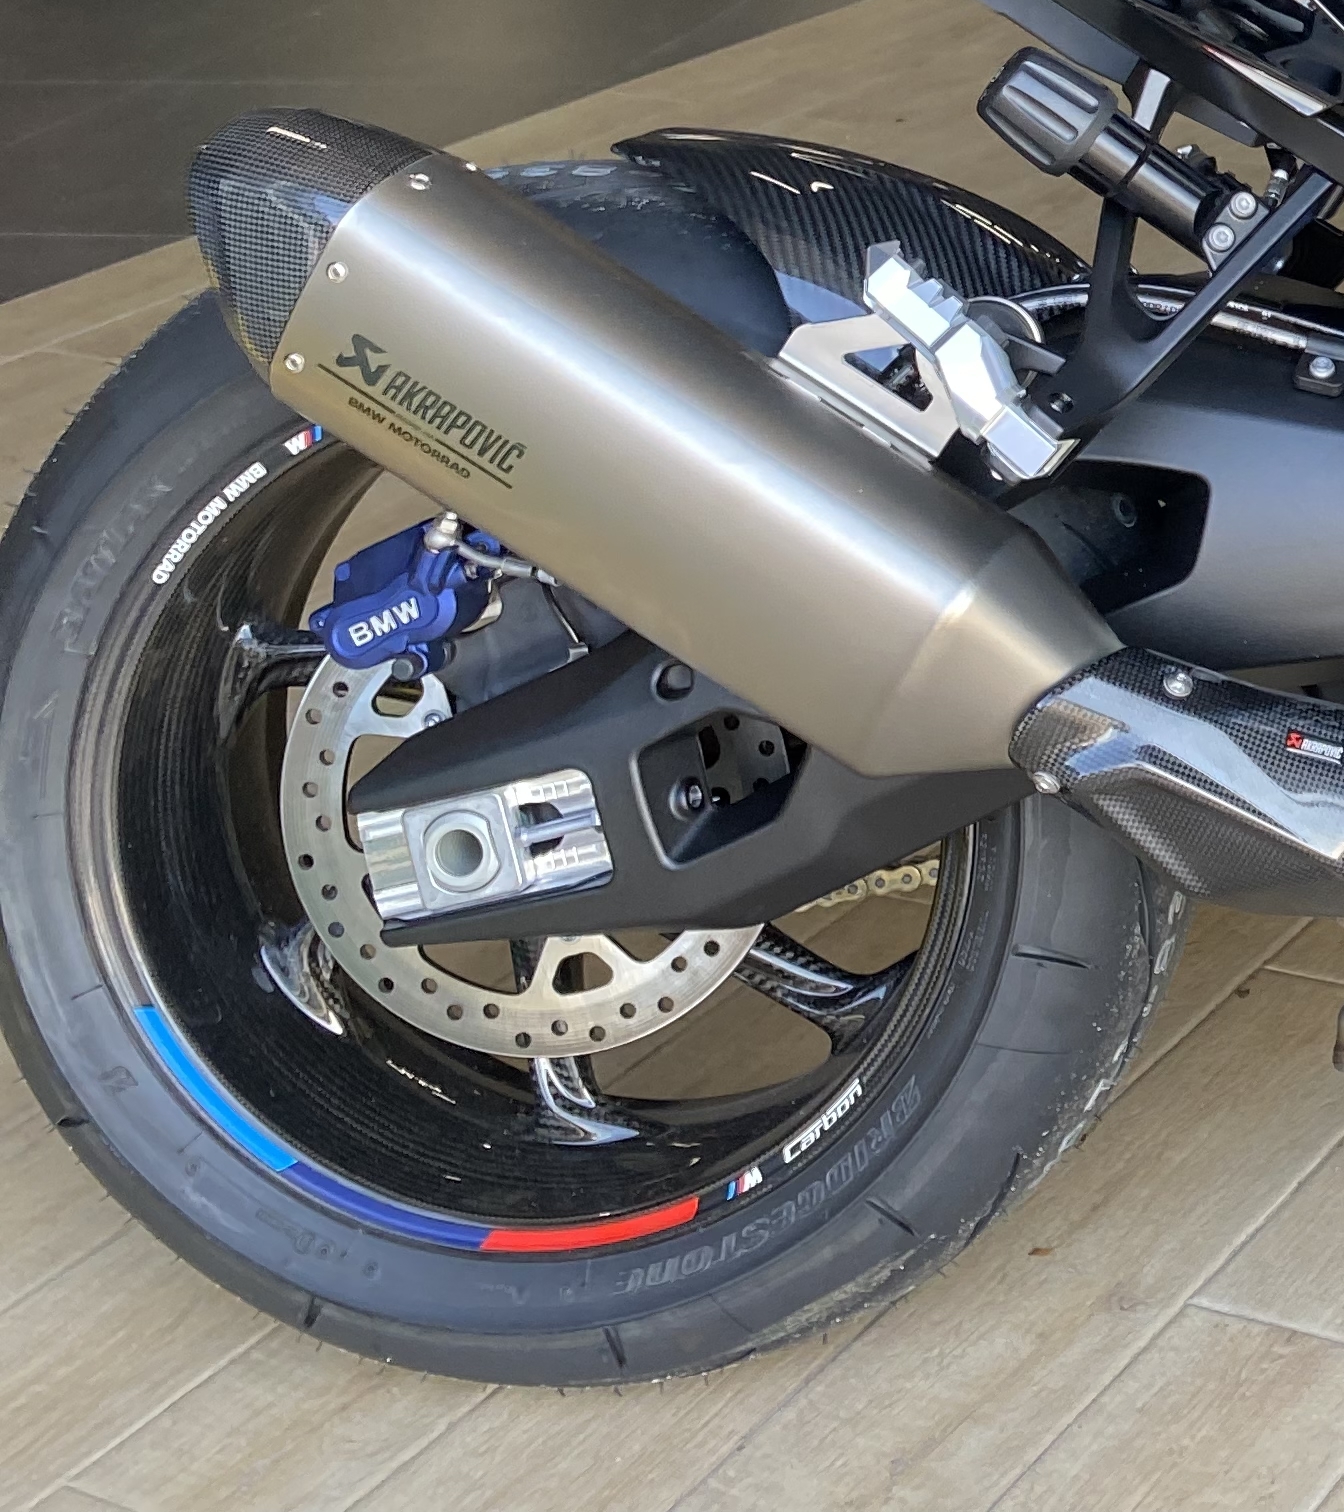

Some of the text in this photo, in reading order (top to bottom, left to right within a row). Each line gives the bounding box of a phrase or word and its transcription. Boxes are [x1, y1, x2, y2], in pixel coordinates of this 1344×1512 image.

[347, 396, 387, 425] BMW
[387, 422, 472, 480] MOTORRAD
[151, 461, 269, 585] BMW MOTORRAD
[347, 596, 420, 647] BMW
[782, 1077, 864, 1164] Carbon
